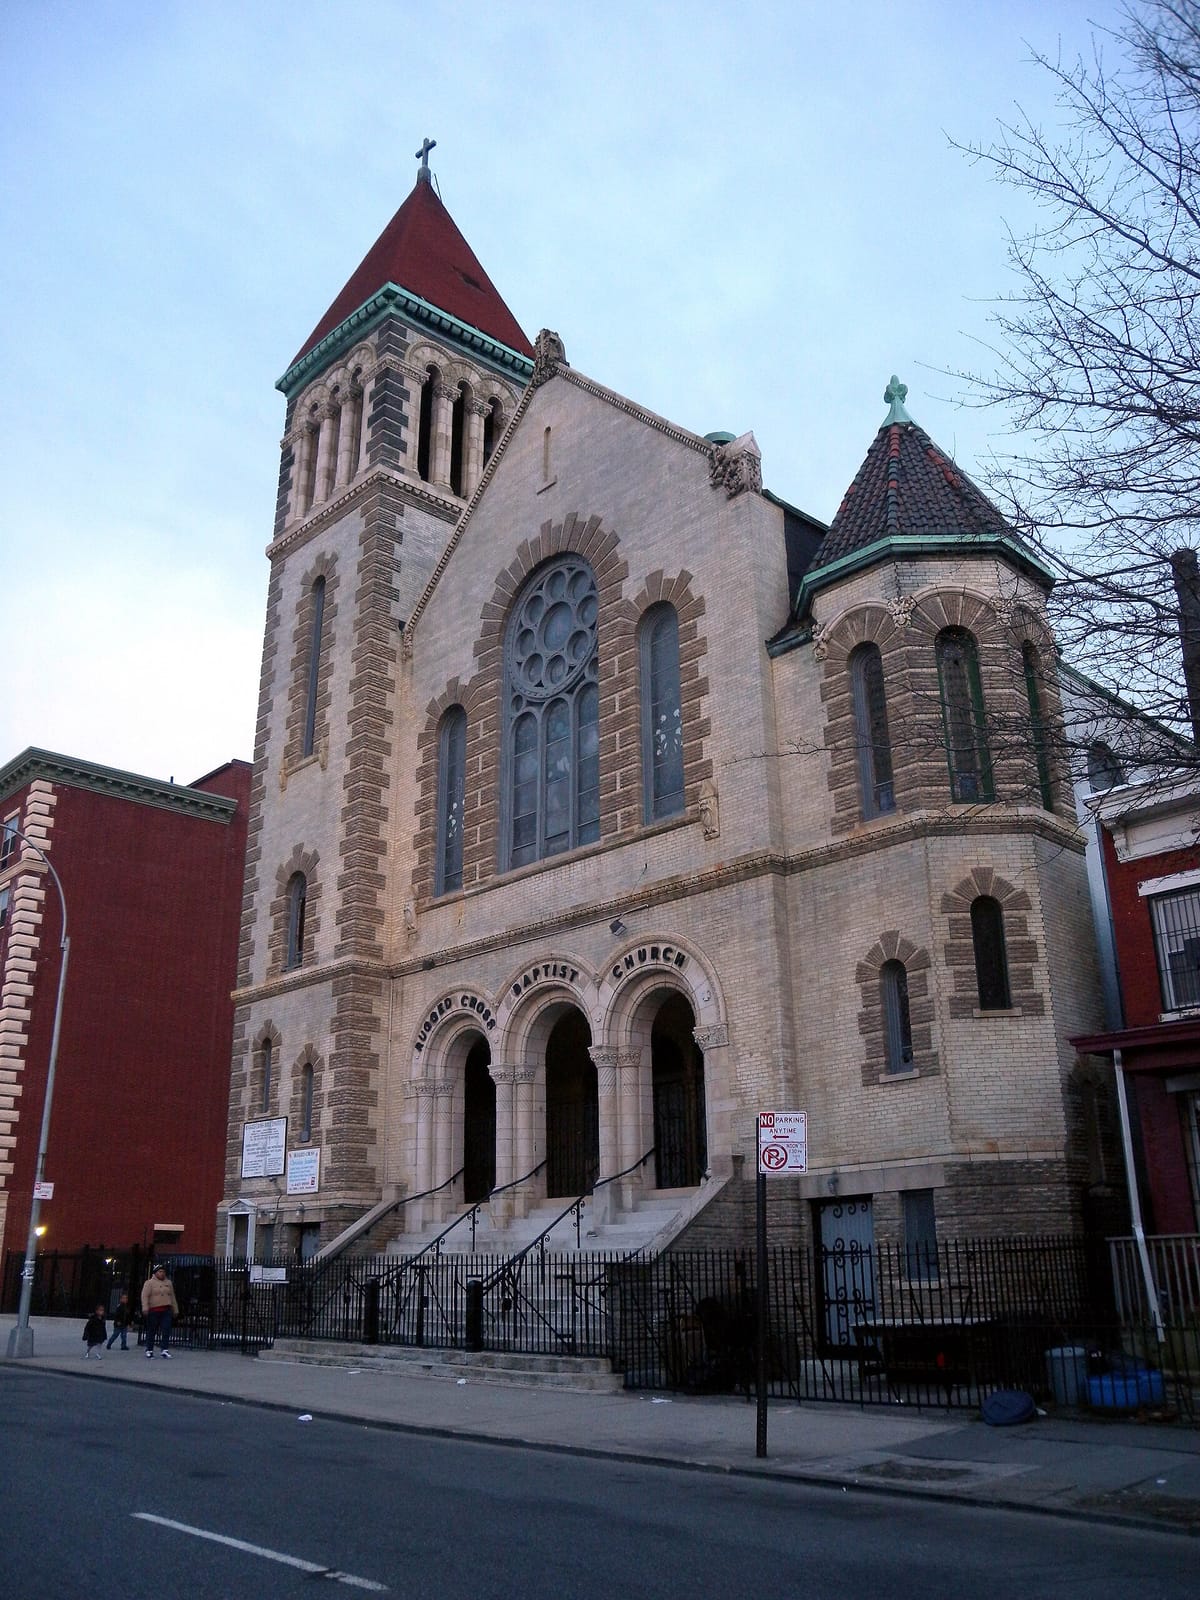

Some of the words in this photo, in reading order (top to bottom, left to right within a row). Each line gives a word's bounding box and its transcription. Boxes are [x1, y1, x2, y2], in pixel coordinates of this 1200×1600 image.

[612, 946, 686, 978] CHURCH
[510, 963, 580, 997] BAPTIST
[414, 997, 452, 1052] RUGGED
[460, 994, 497, 1031] CROSS
[760, 1115, 774, 1126] NO
[775, 1116, 804, 1124] PARKING
